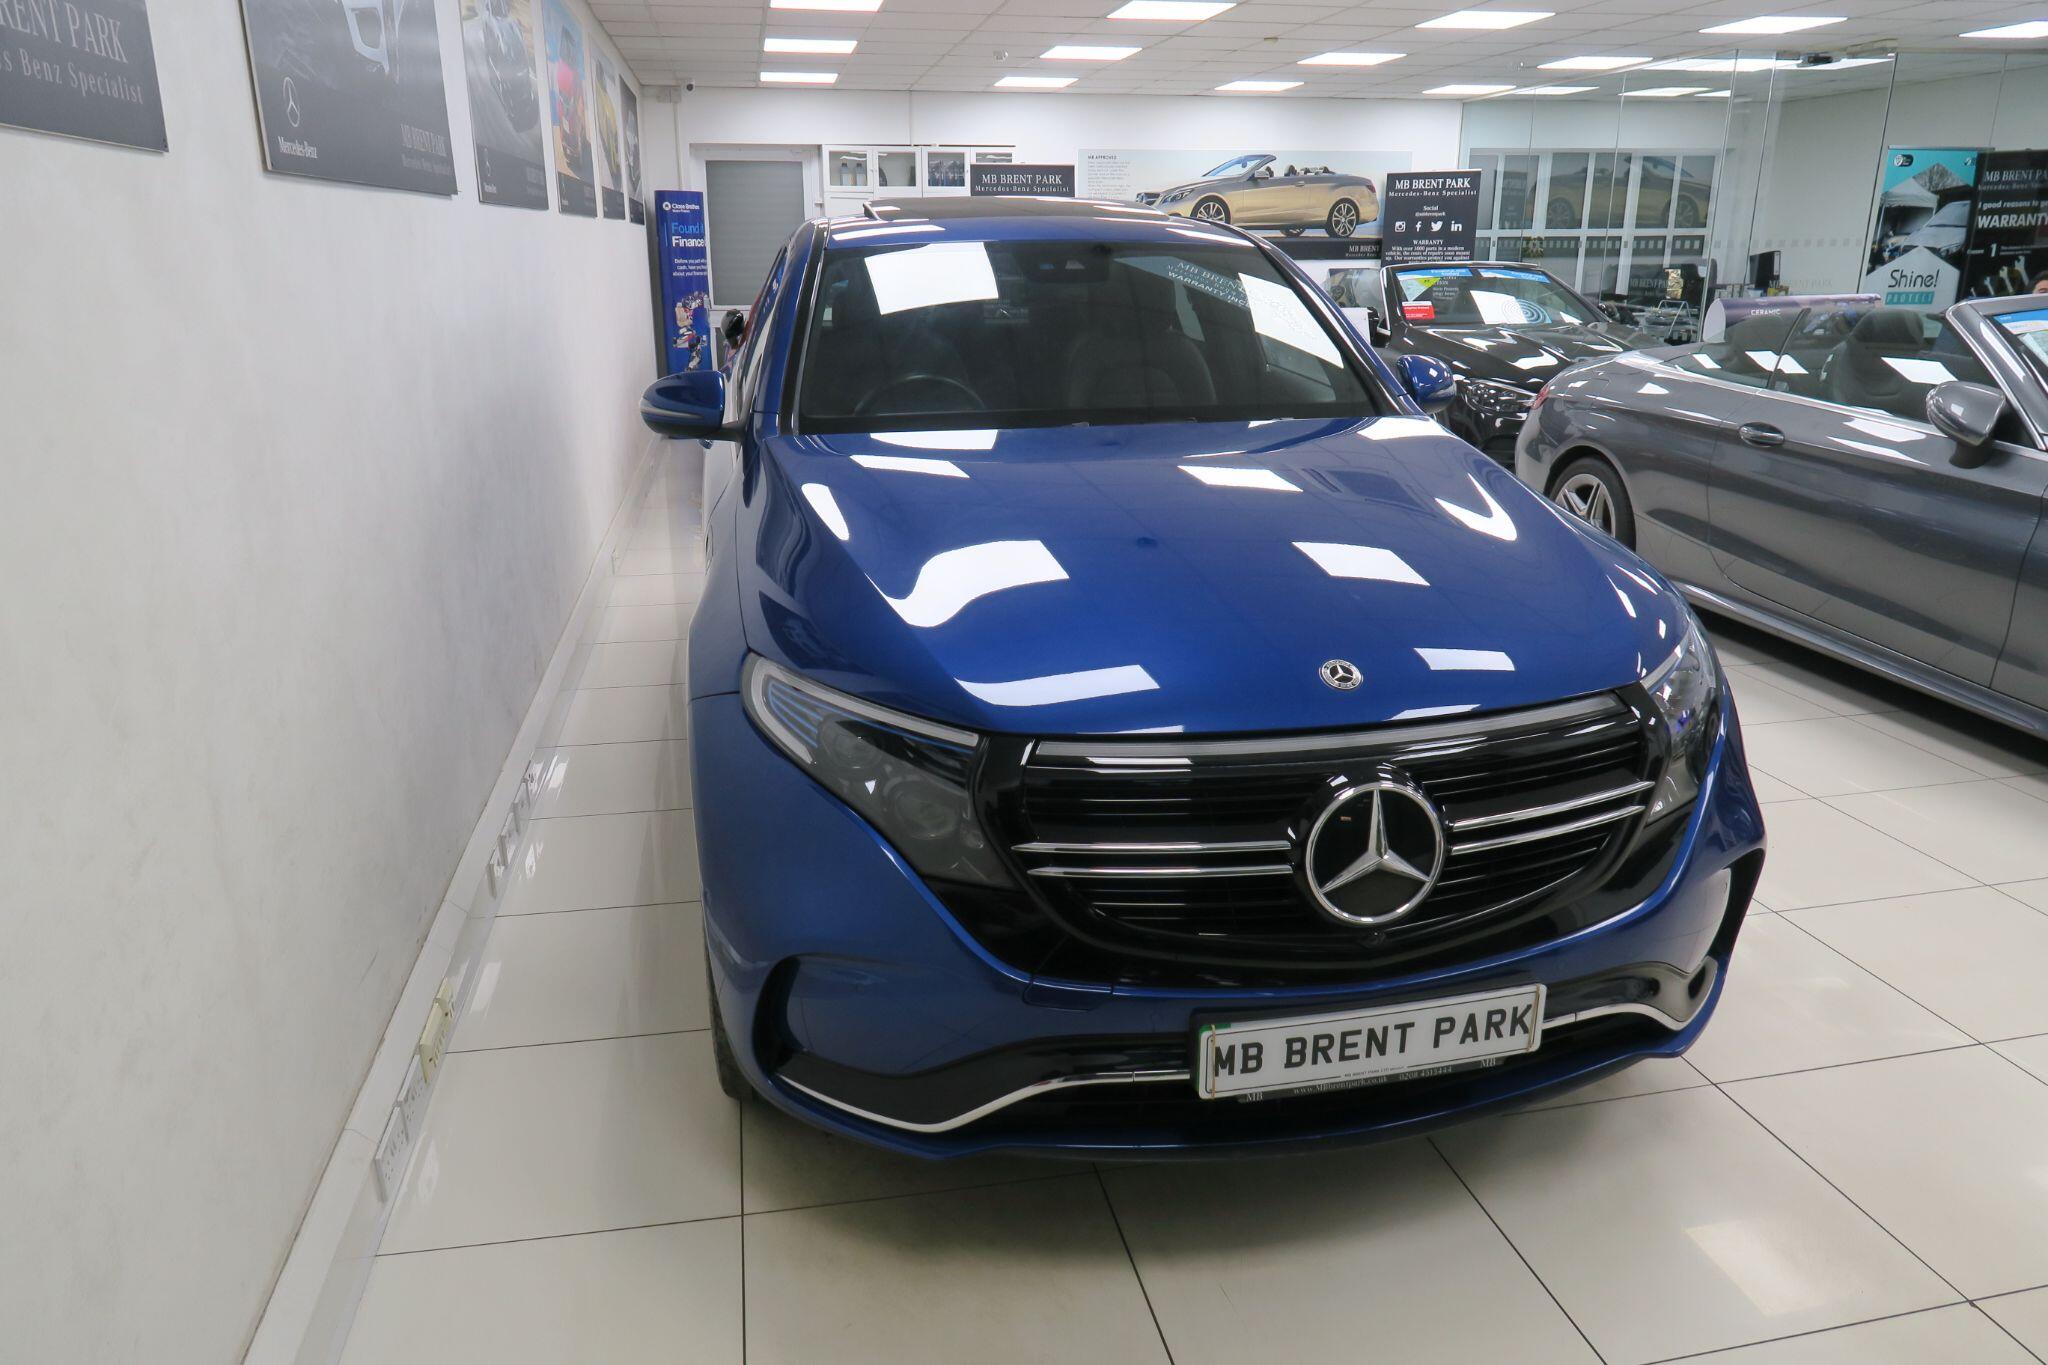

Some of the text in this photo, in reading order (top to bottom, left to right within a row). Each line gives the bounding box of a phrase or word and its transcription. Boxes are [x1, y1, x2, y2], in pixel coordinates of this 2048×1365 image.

[65, 2, 128, 63] PARK
[18, 48, 62, 84] Benz
[67, 62, 144, 104] Specialist
[982, 174, 1062, 185] MB BRENT PARK
[1985, 171, 2000, 182] MB
[2002, 169, 2033, 181] BRENT
[1033, 185, 1069, 193] Specialist
[1395, 177, 1471, 190] MB BRENT PARK
[1442, 189, 1477, 197] Specialist
[1982, 201, 2002, 210] good
[672, 222, 699, 234] Found
[672, 236, 705, 247] Finance
[1991, 243, 1997, 257] 1
[1168, 271, 1225, 297] WARRANTY
[1888, 269, 1940, 288] Shine!
[1751, 308, 1781, 316] CERAMIC
[1214, 1003, 1533, 1078] MB BRENT PARK
[1247, 1092, 1263, 1102] MB
[1480, 1057, 1496, 1067] MB
